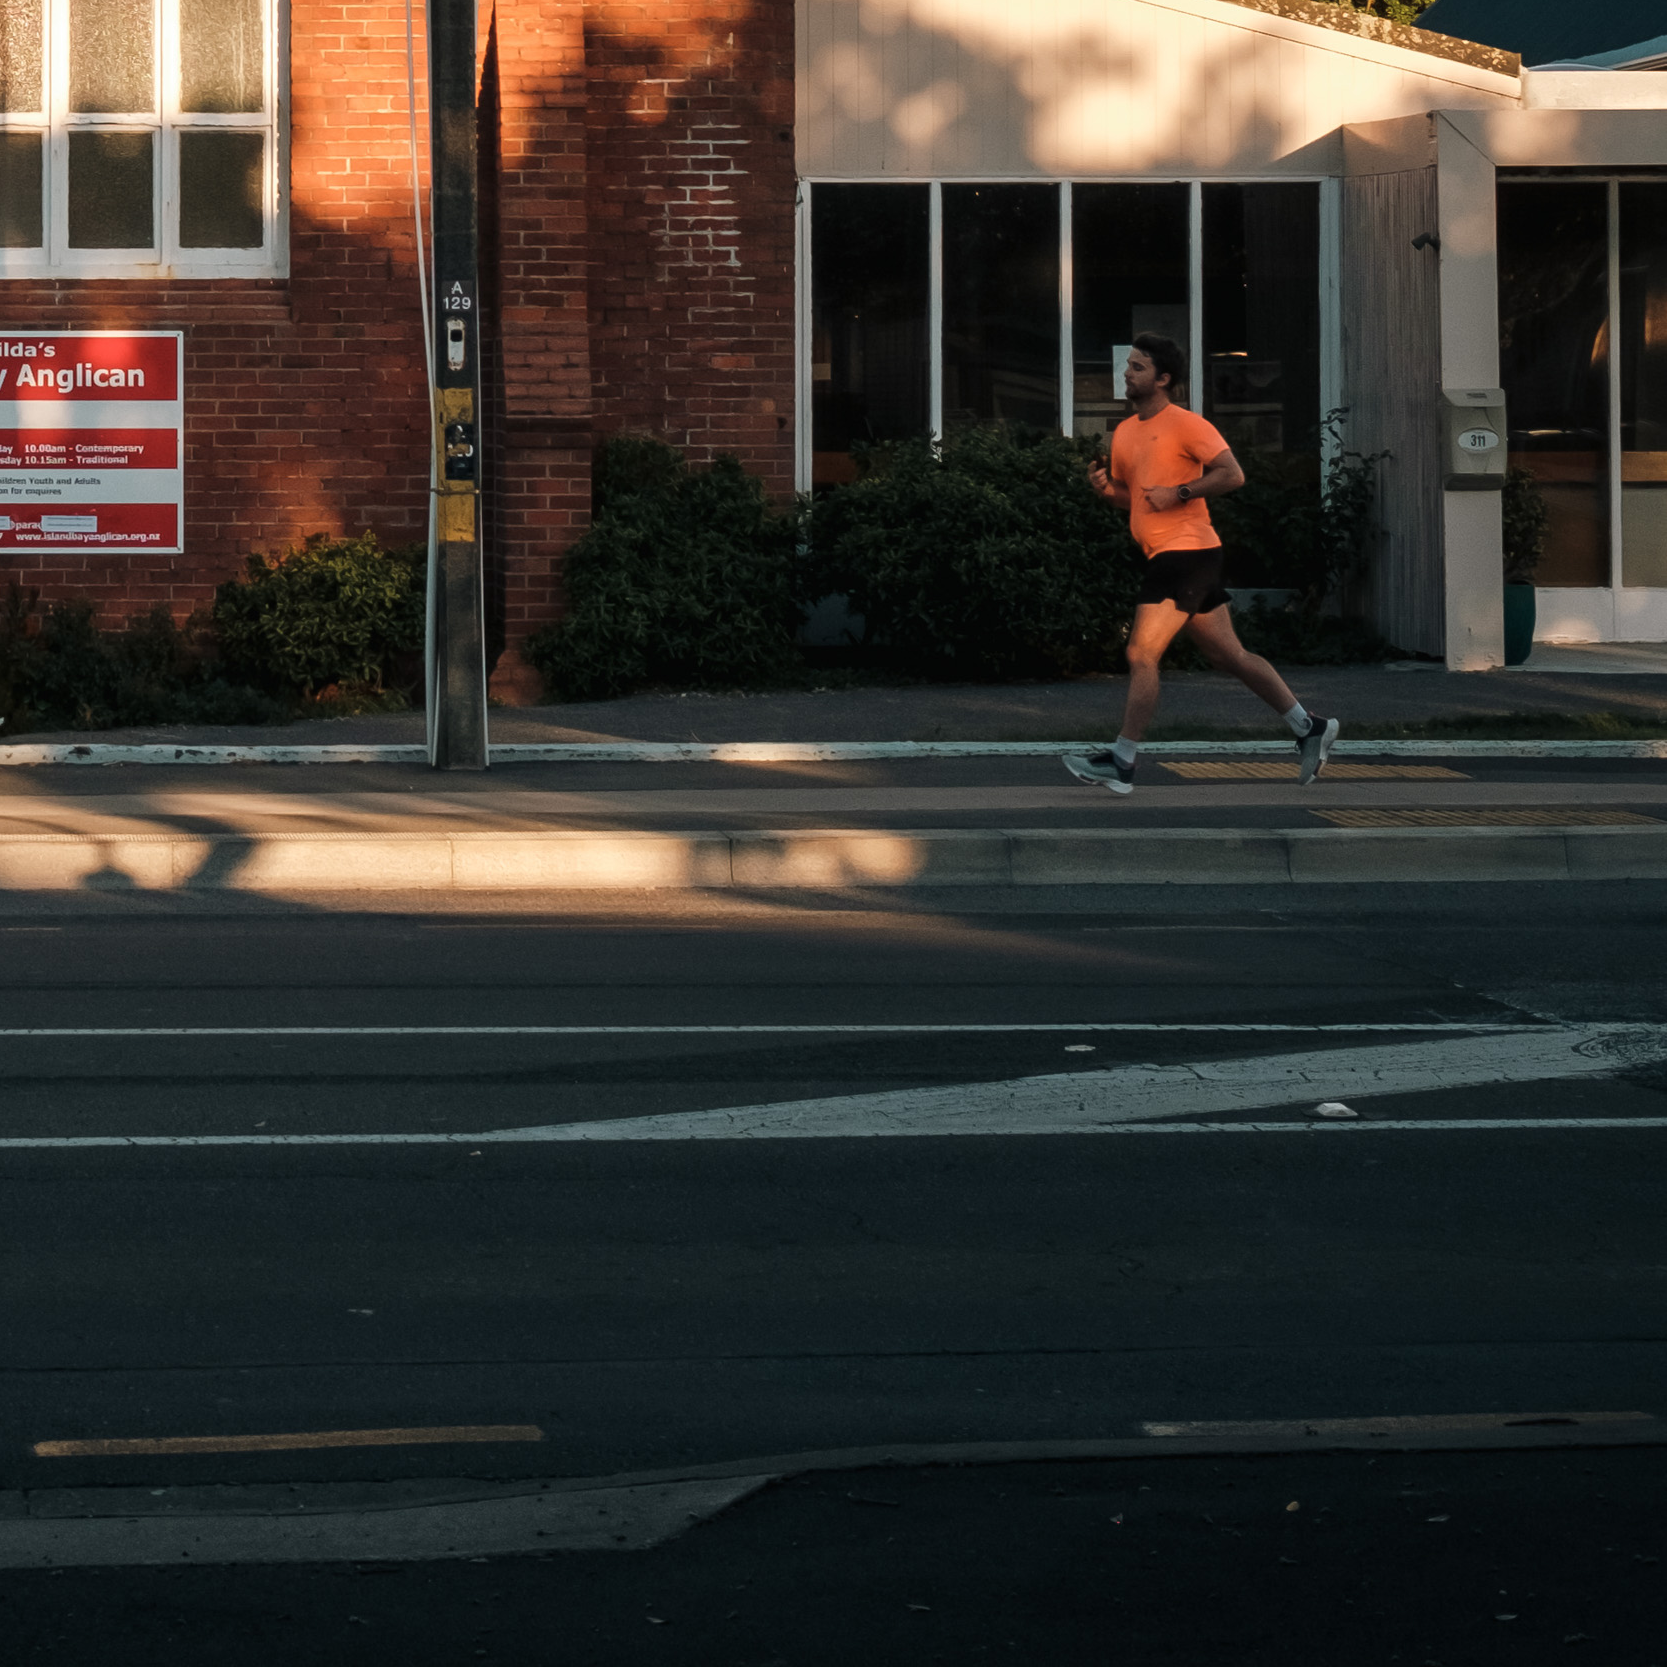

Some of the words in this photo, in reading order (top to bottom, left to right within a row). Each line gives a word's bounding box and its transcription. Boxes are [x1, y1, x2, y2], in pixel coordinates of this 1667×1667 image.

[450, 281, 463, 295] A
[442, 296, 471, 310] 129
[16, 363, 145, 393] Anglican
[1470, 434, 1486, 447] 311
[24, 444, 66, 454] 10.00am
[75, 444, 145, 455] Contemporary
[24, 455, 66, 465] 10.15am
[76, 455, 129, 465] Traditional
[29, 477, 54, 485] Youth
[56, 477, 72, 485] and
[74, 477, 101, 485] Adults
[11, 487, 23, 495] for
[15, 531, 161, 543] www.islandbayanglican.org.nz
